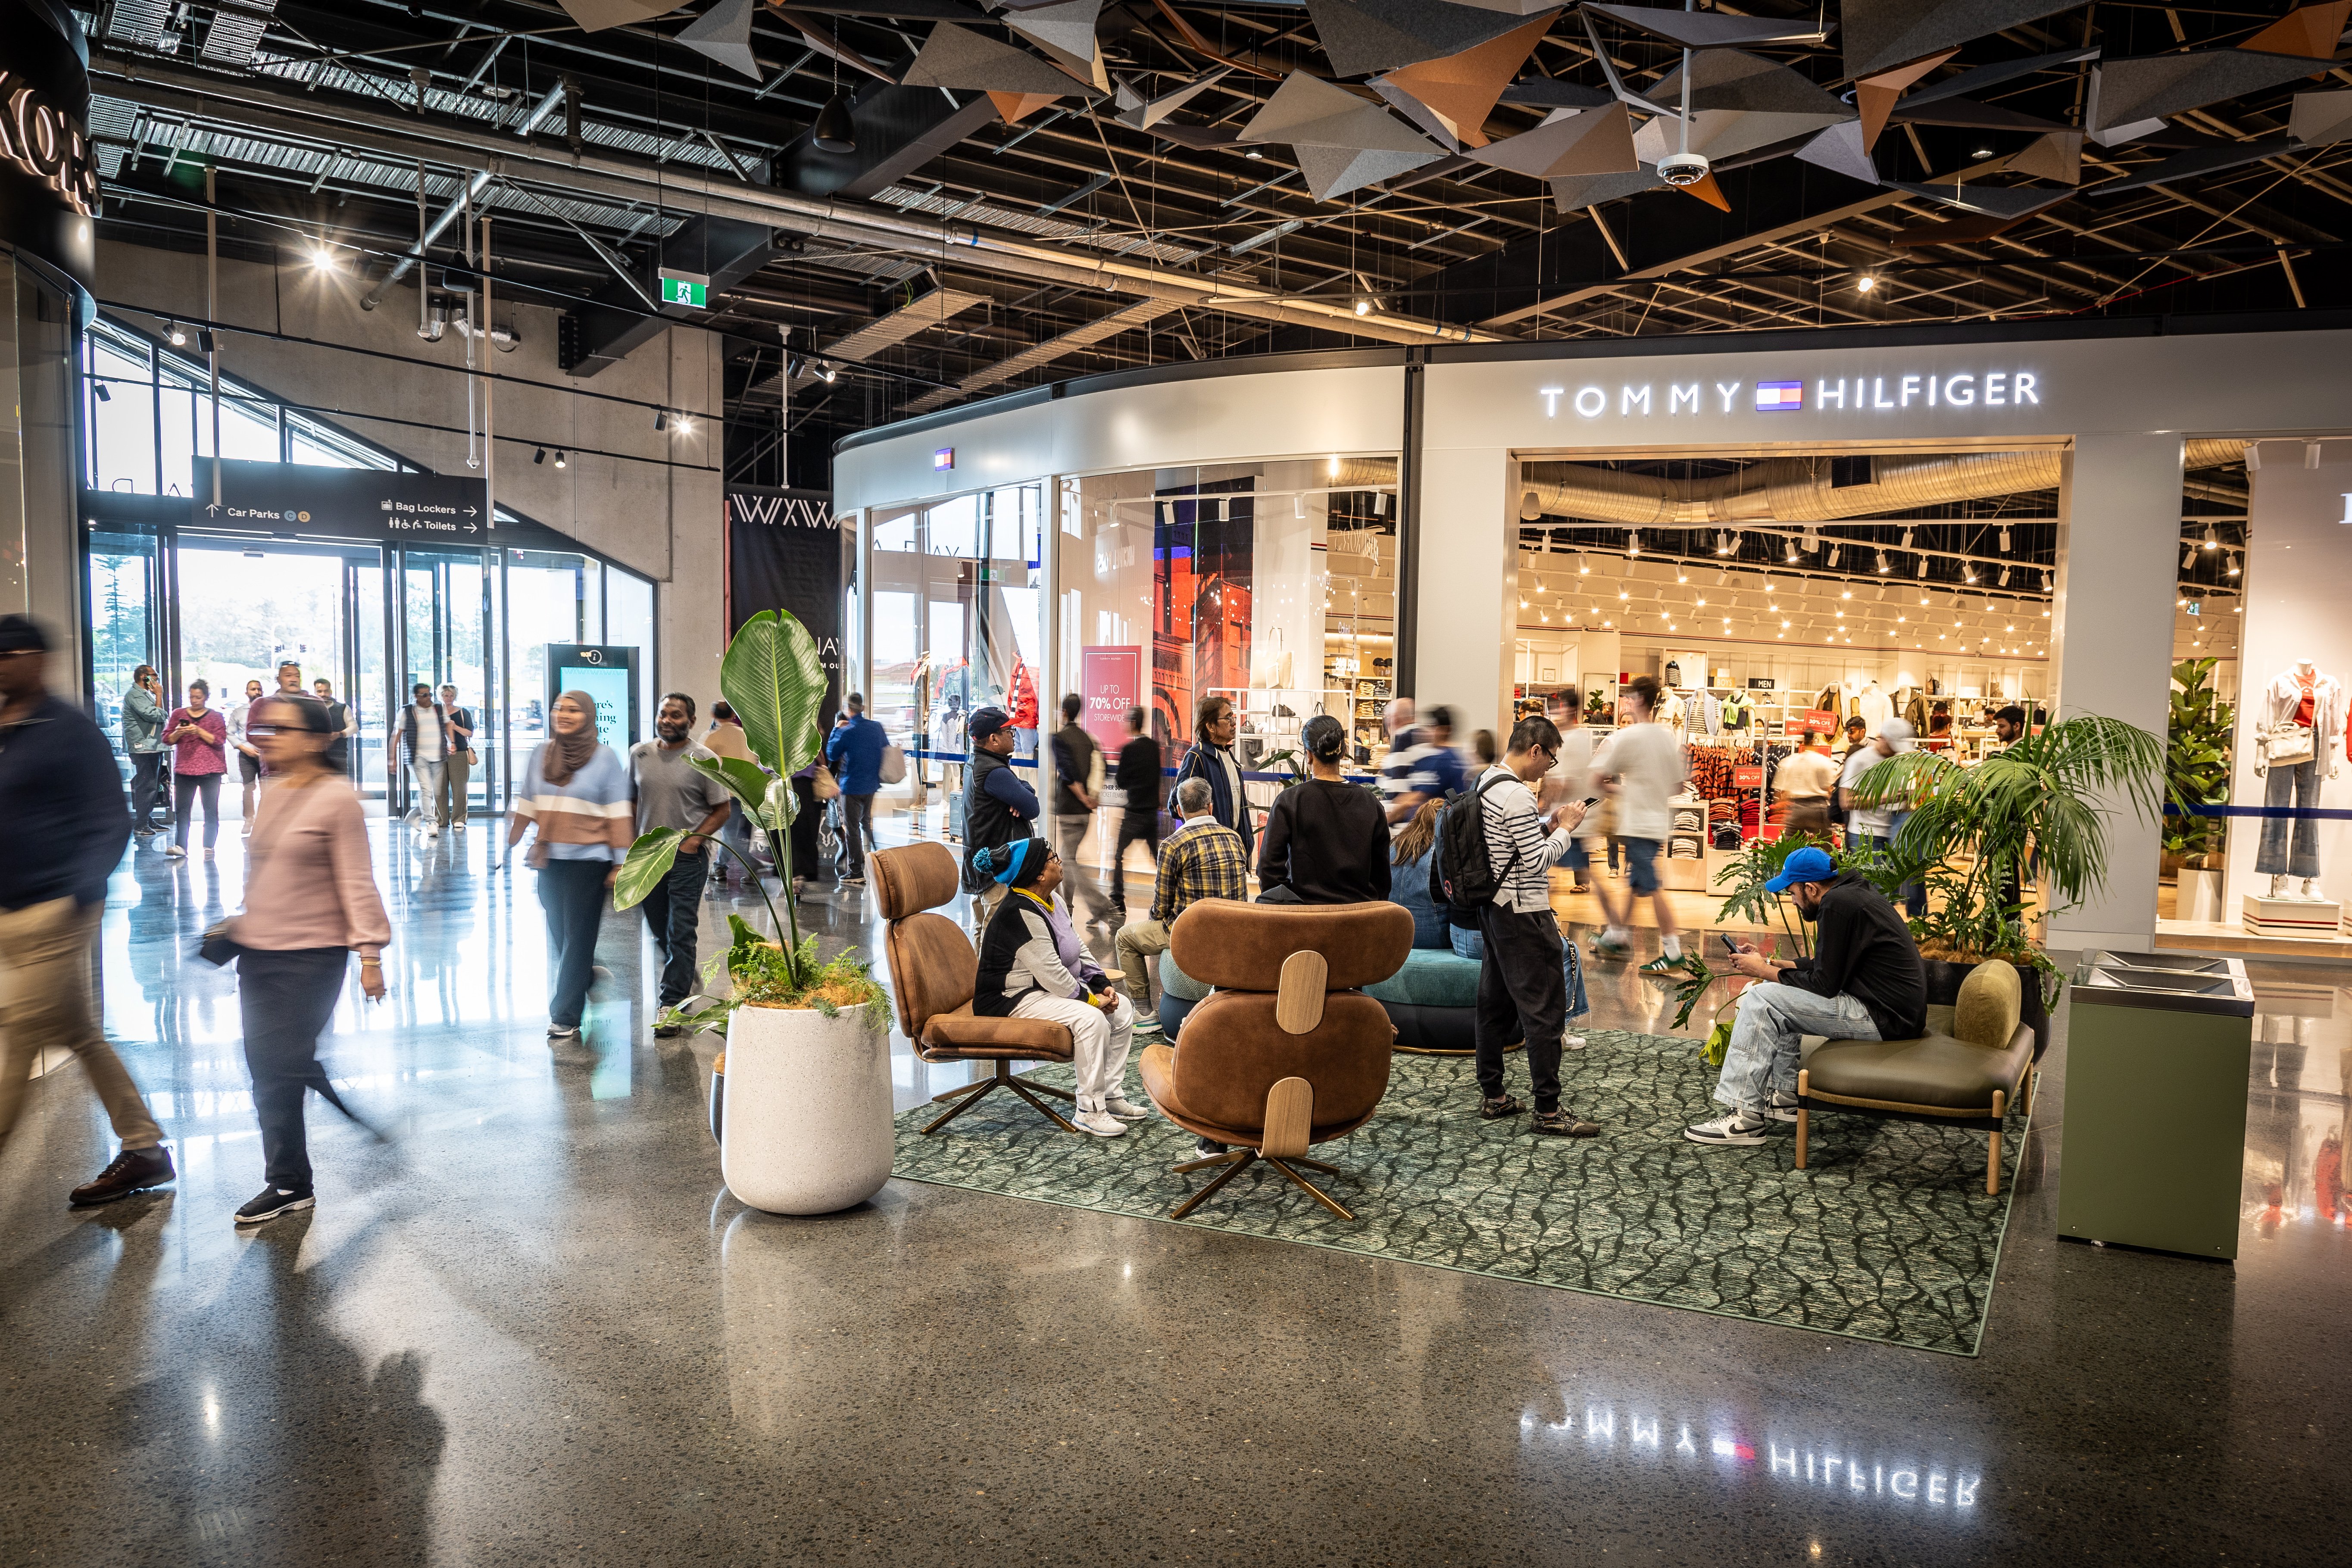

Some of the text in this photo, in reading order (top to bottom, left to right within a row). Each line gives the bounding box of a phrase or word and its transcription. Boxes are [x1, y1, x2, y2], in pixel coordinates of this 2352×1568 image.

[1540, 373, 2038, 417] TOMMY HILFIGER
[396, 502, 456, 514] Bag Lockers
[228, 508, 247, 517] Car
[250, 509, 280, 519] Parks
[424, 521, 456, 531] Toilets
[1100, 684, 1119, 694] UP TO
[594, 700, 613, 709] re's
[1090, 697, 1131, 710] 70% OFF
[1094, 713, 1125, 722] STOREWIDE
